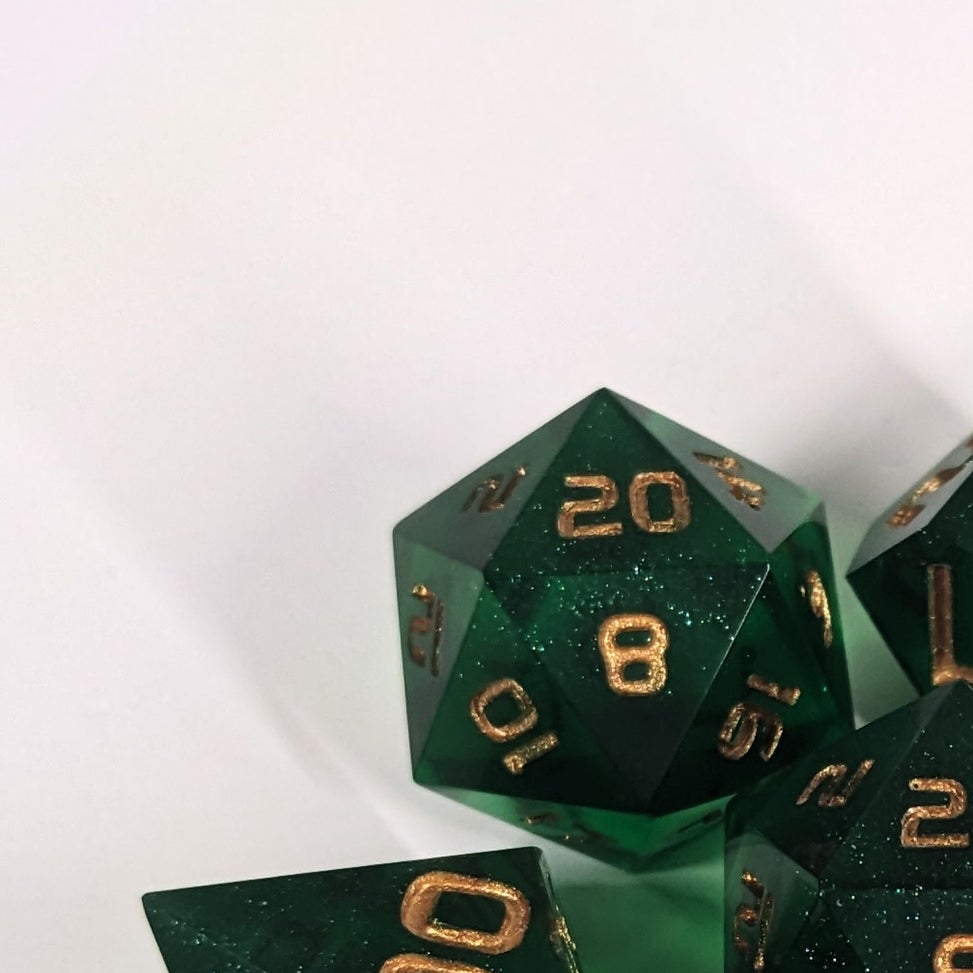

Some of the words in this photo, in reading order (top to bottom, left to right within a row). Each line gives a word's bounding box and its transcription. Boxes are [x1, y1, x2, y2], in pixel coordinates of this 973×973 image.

[557, 471, 691, 538] 20
[598, 612, 670, 697] 8
[470, 678, 560, 775] 10
